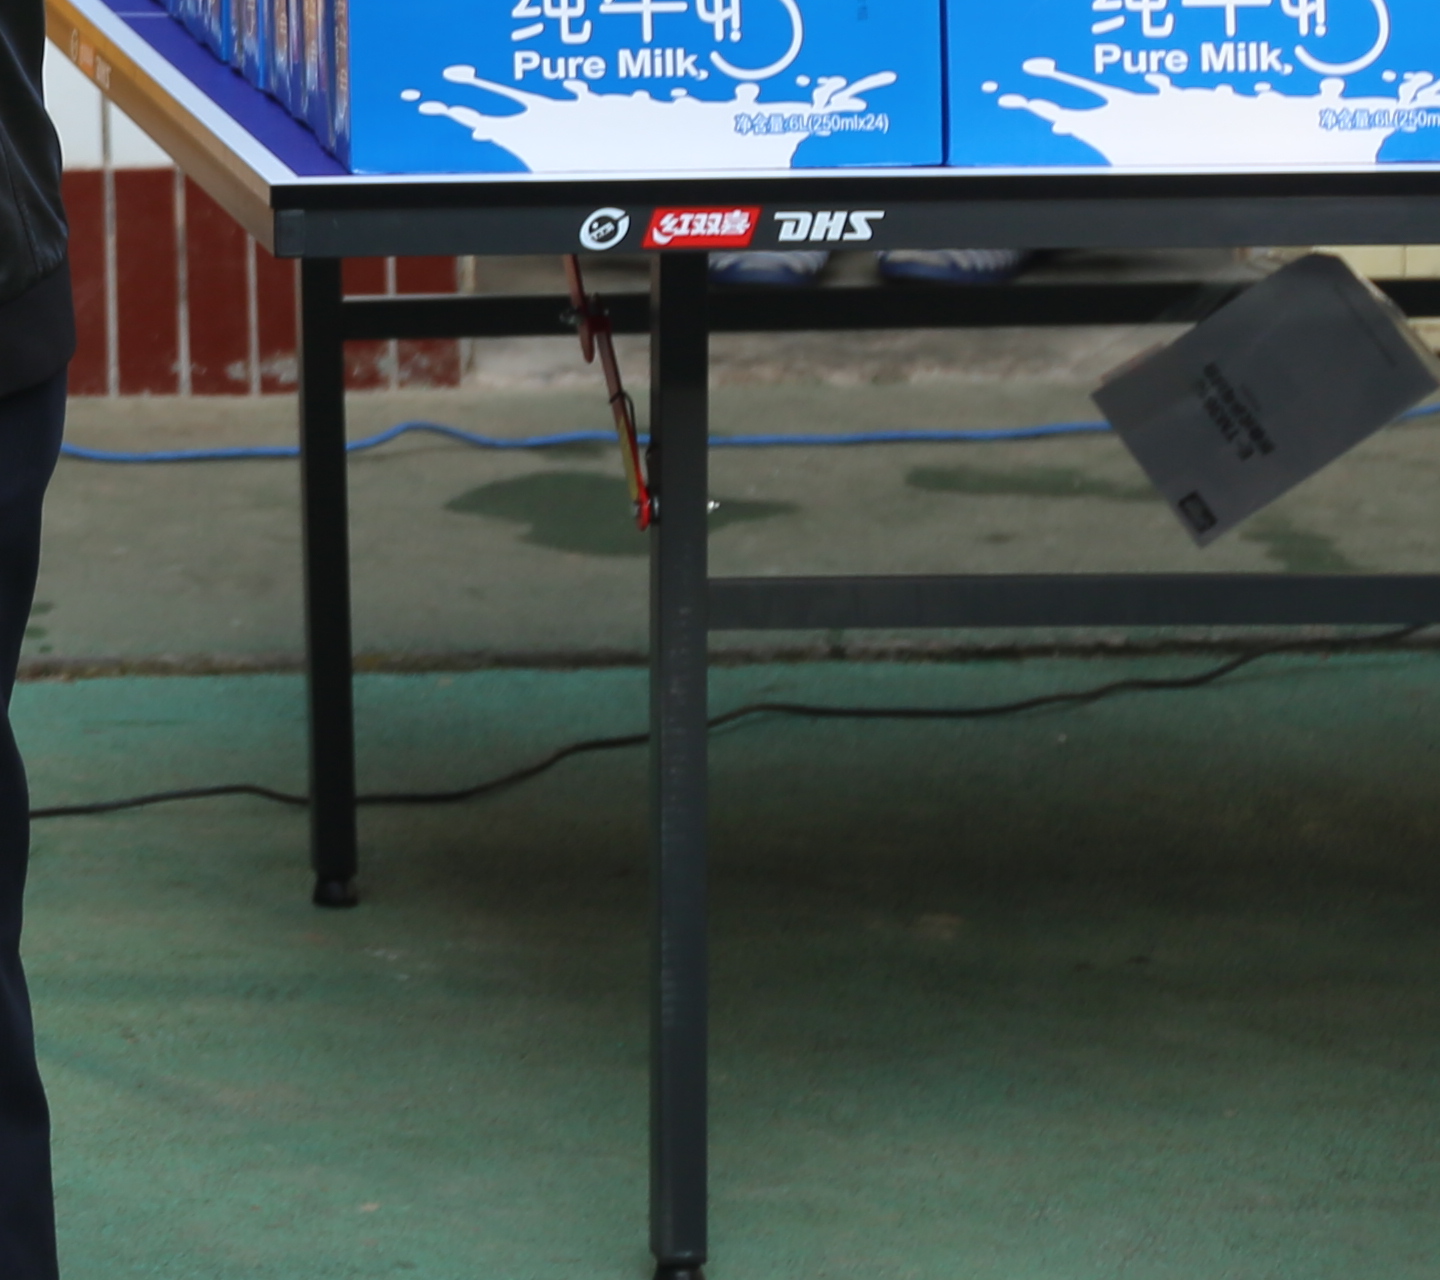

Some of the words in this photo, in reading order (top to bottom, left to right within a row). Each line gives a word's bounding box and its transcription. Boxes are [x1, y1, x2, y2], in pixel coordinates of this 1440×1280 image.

[513, 50, 606, 80] Pure
[1094, 44, 1189, 74] Pure
[774, 210, 885, 242] DHS
